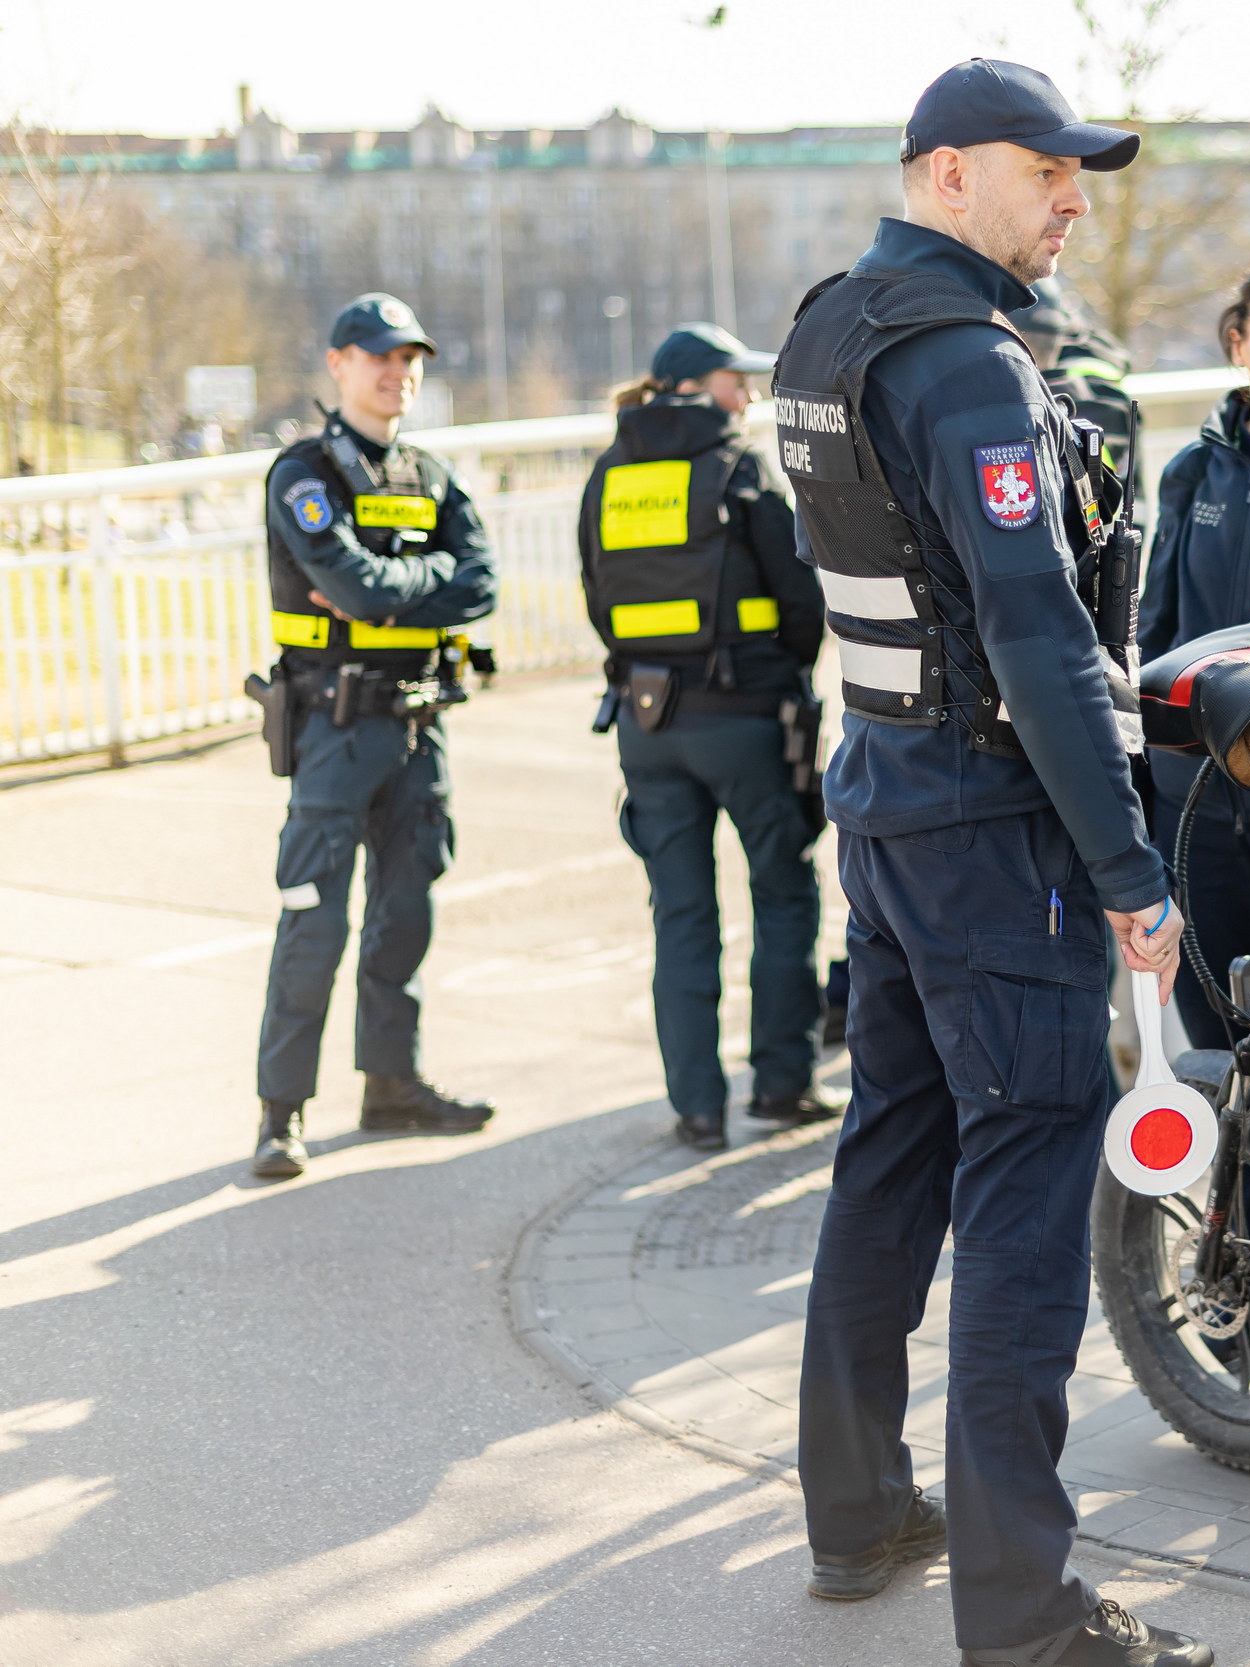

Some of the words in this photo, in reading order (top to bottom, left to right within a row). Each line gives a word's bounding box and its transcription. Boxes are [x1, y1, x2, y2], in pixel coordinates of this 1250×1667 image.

[797, 400, 847, 434] TVARKOS
[783, 439, 813, 473] GRUPĖ
[981, 445, 1028, 456] VIEŠOSIOS
[985, 452, 1026, 462] TVARKOS
[1000, 515, 1032, 528] VILNIUS
